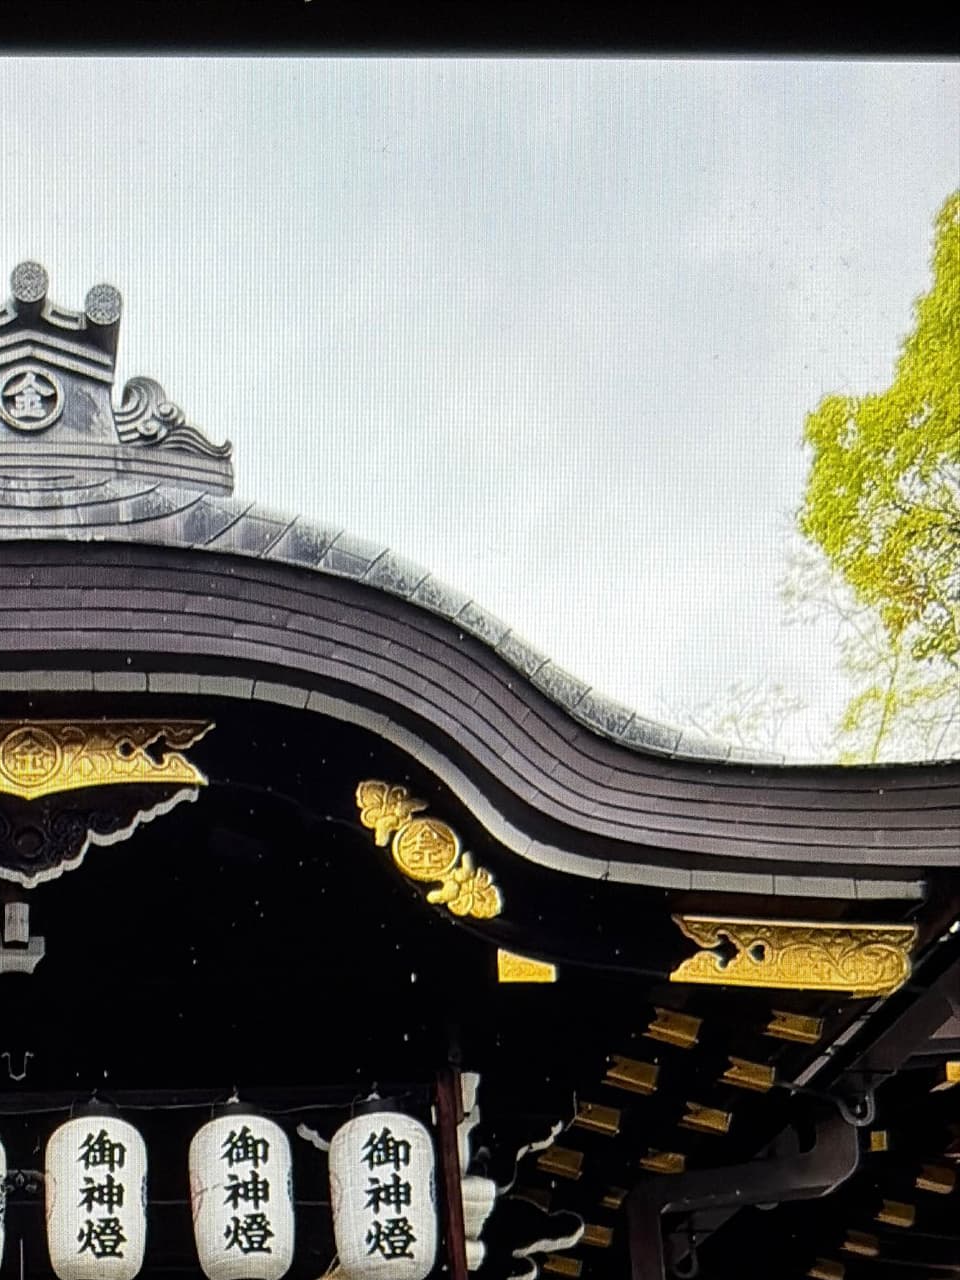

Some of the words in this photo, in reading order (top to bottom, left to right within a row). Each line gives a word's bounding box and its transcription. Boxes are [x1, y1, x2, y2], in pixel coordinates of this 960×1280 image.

[2, 371, 58, 419] 金
[77, 1129, 128, 1260] 御神燈
[220, 1125, 275, 1256] 御神燈
[360, 1127, 417, 1260] 御神燈
